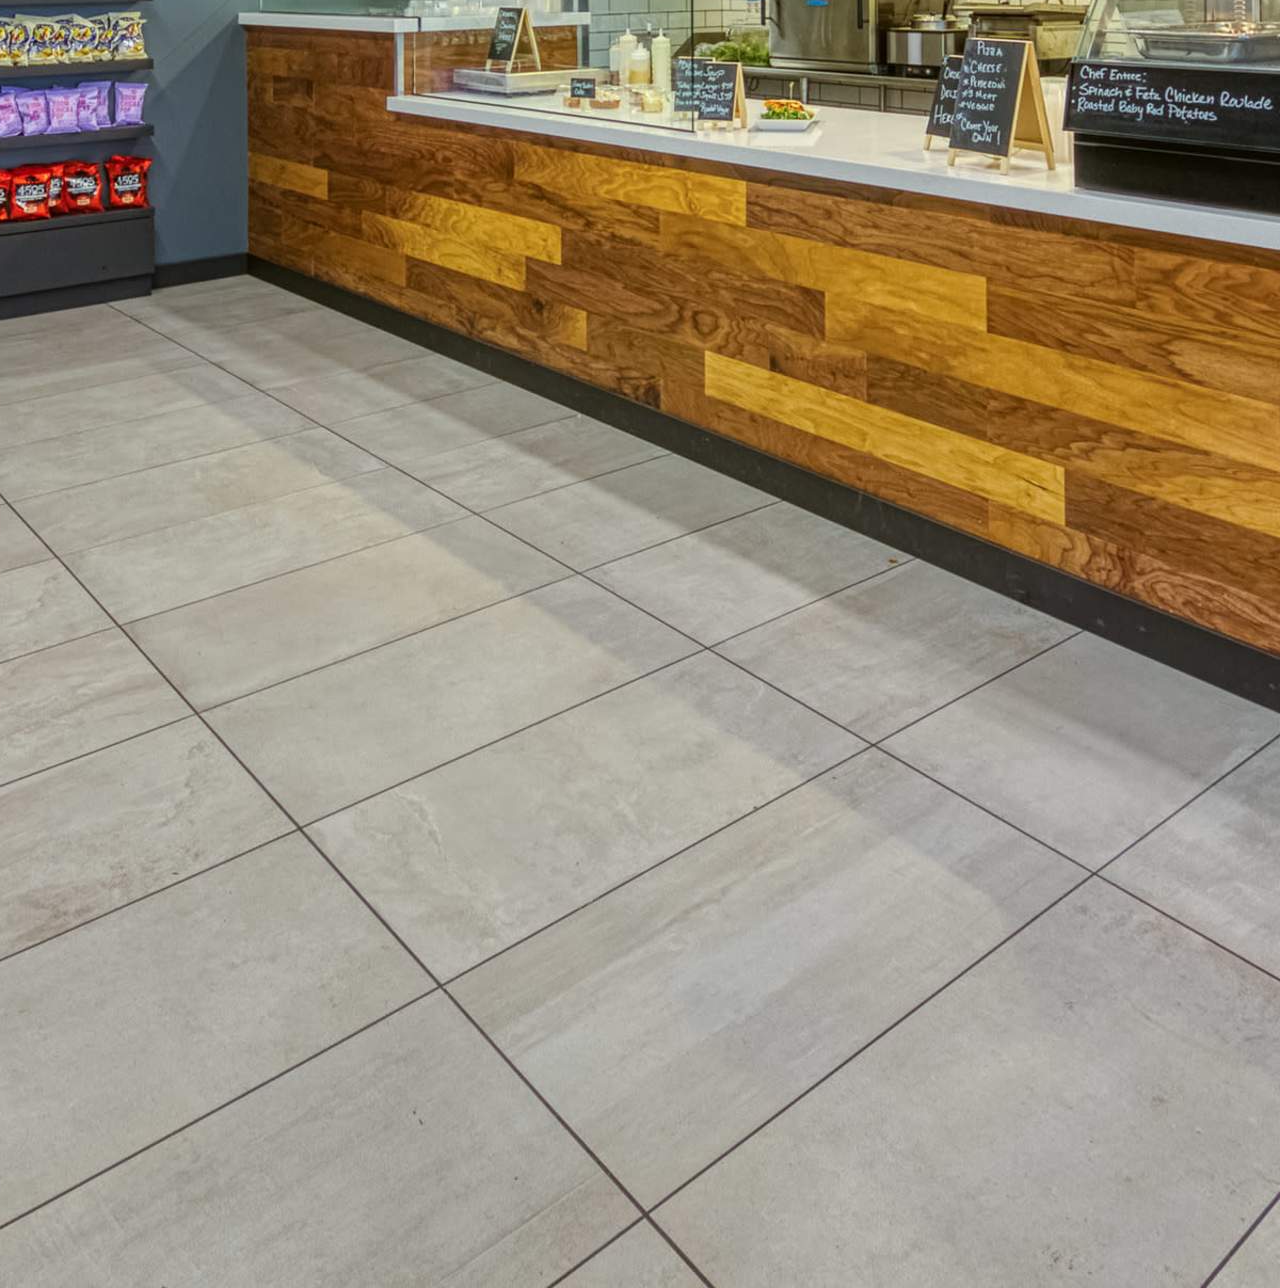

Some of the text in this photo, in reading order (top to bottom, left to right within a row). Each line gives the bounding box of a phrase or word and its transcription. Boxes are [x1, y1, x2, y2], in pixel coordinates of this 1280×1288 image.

[1079, 65, 1107, 79] Chef
[1078, 83, 1123, 98] Spinach
[1135, 87, 1161, 101] Feta
[1164, 86, 1215, 104] Chicken
[1077, 99, 1218, 121] Roasted Baby Red Potatoes
